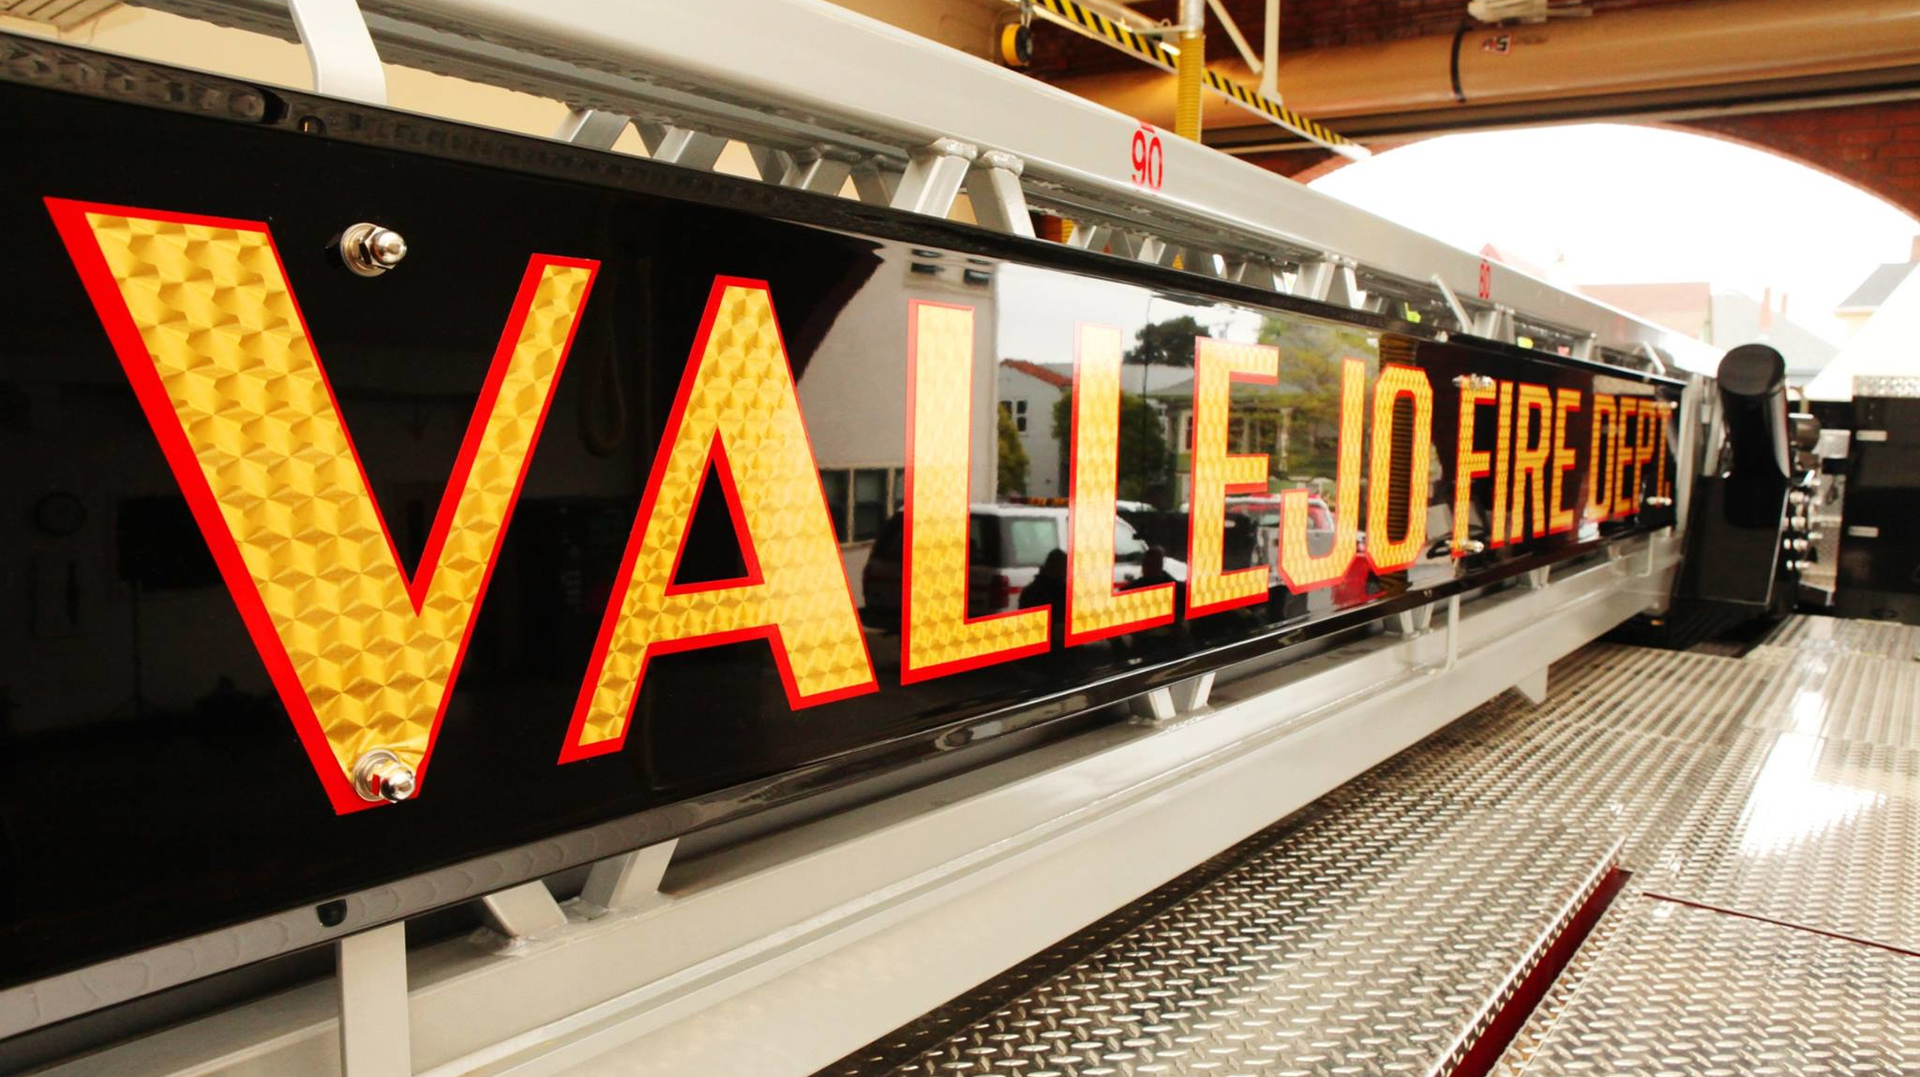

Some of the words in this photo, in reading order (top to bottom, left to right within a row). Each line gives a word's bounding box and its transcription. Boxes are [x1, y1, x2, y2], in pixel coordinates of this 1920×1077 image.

[1132, 129, 1163, 191] 90
[44, 196, 1433, 815] VALLEJO
[1451, 375, 1581, 559] FIRE
